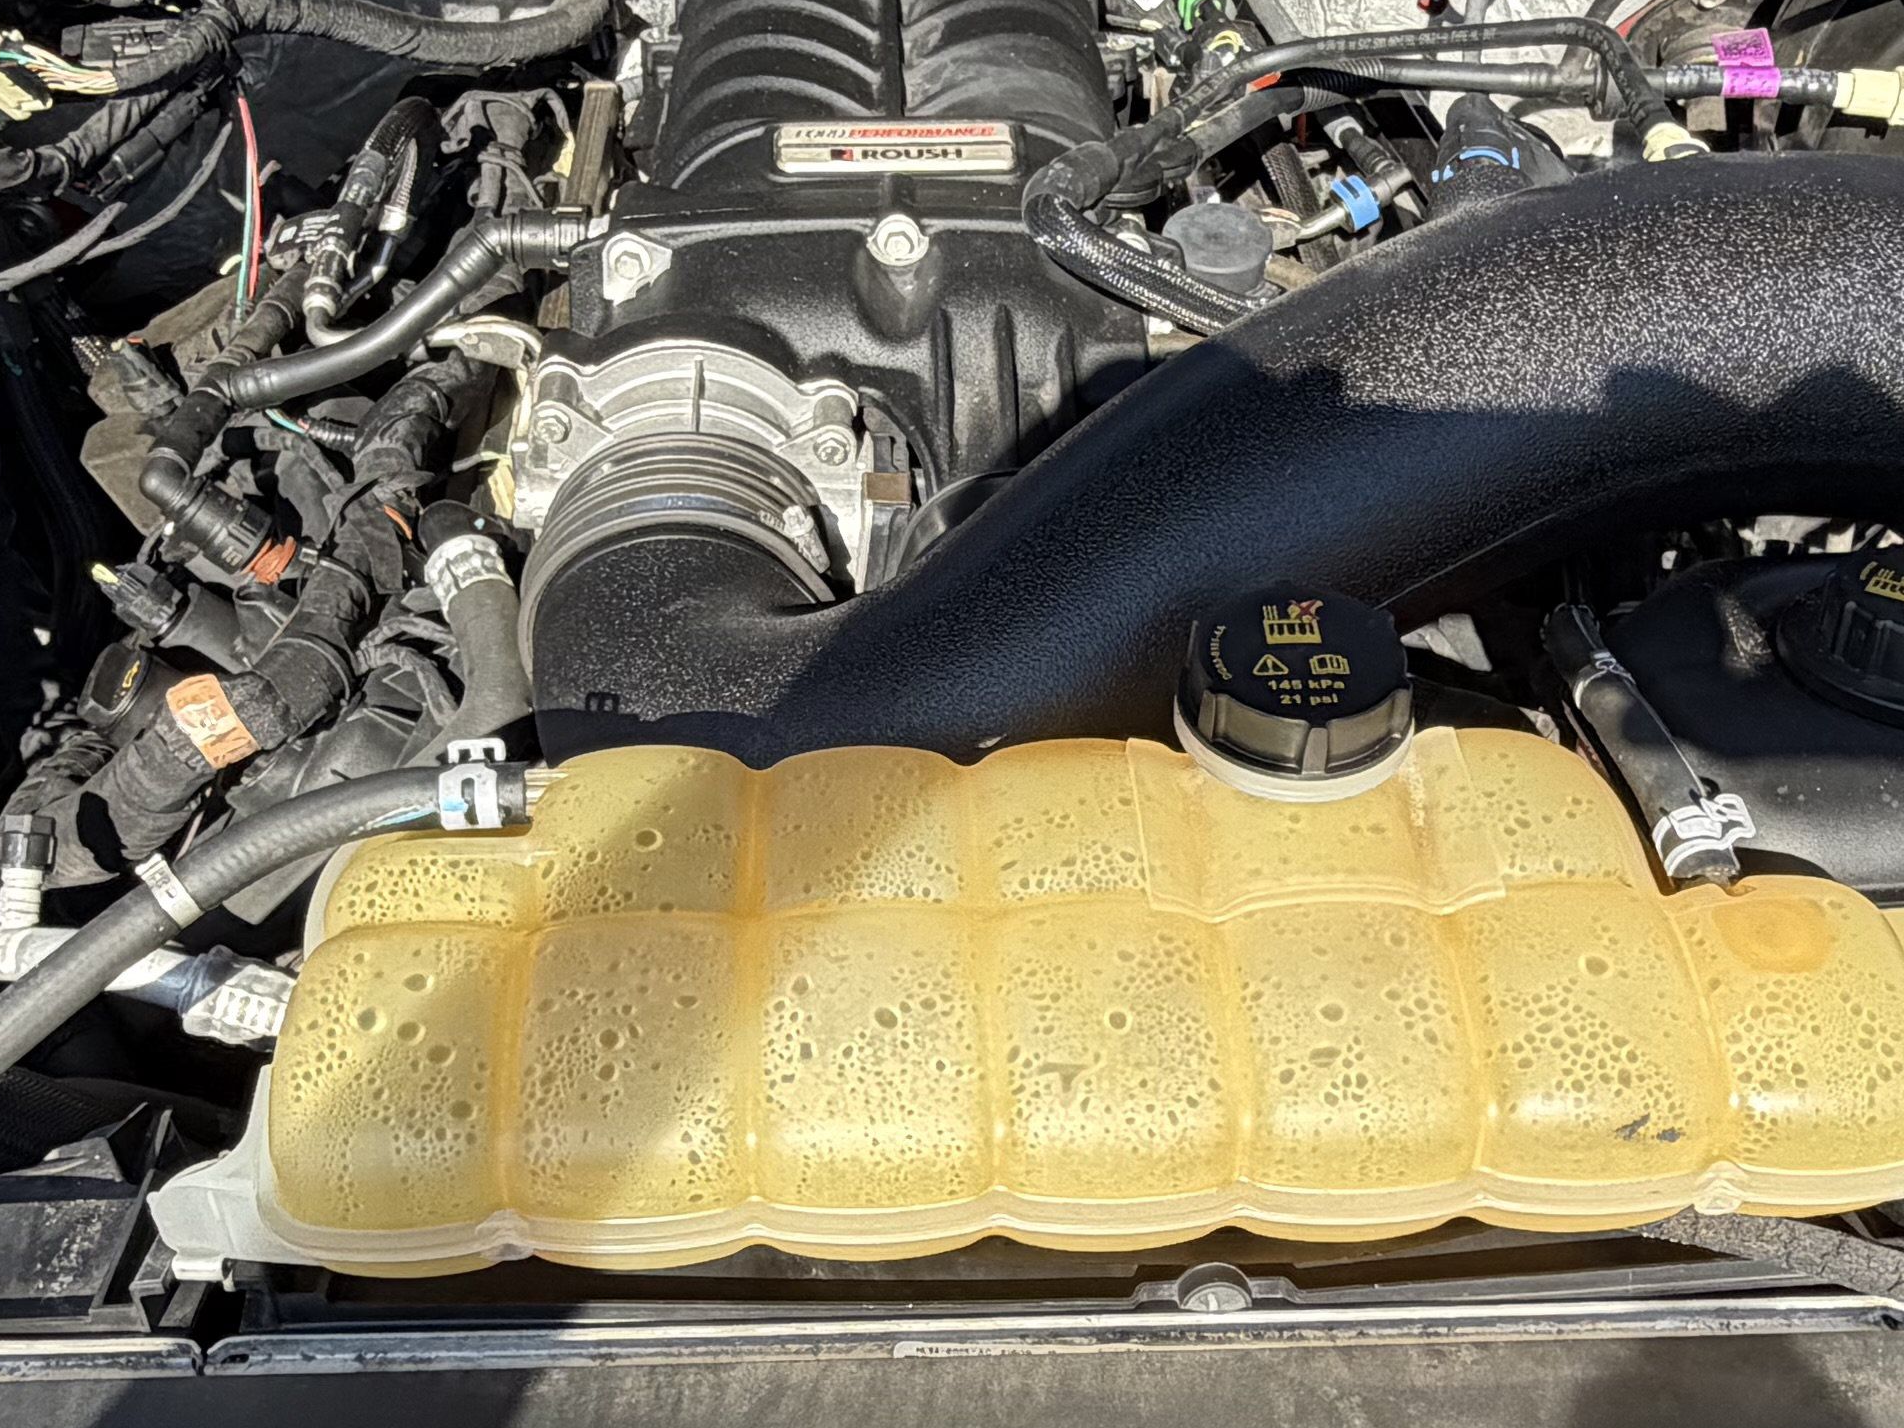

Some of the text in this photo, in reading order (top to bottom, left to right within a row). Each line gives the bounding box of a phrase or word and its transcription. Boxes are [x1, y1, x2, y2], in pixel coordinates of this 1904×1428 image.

[849, 126, 994, 138] PERFORMANCE
[861, 148, 963, 160] ROUSH
[1268, 679, 1346, 691] 145 kPa
[1280, 693, 1339, 707] 21 psi
